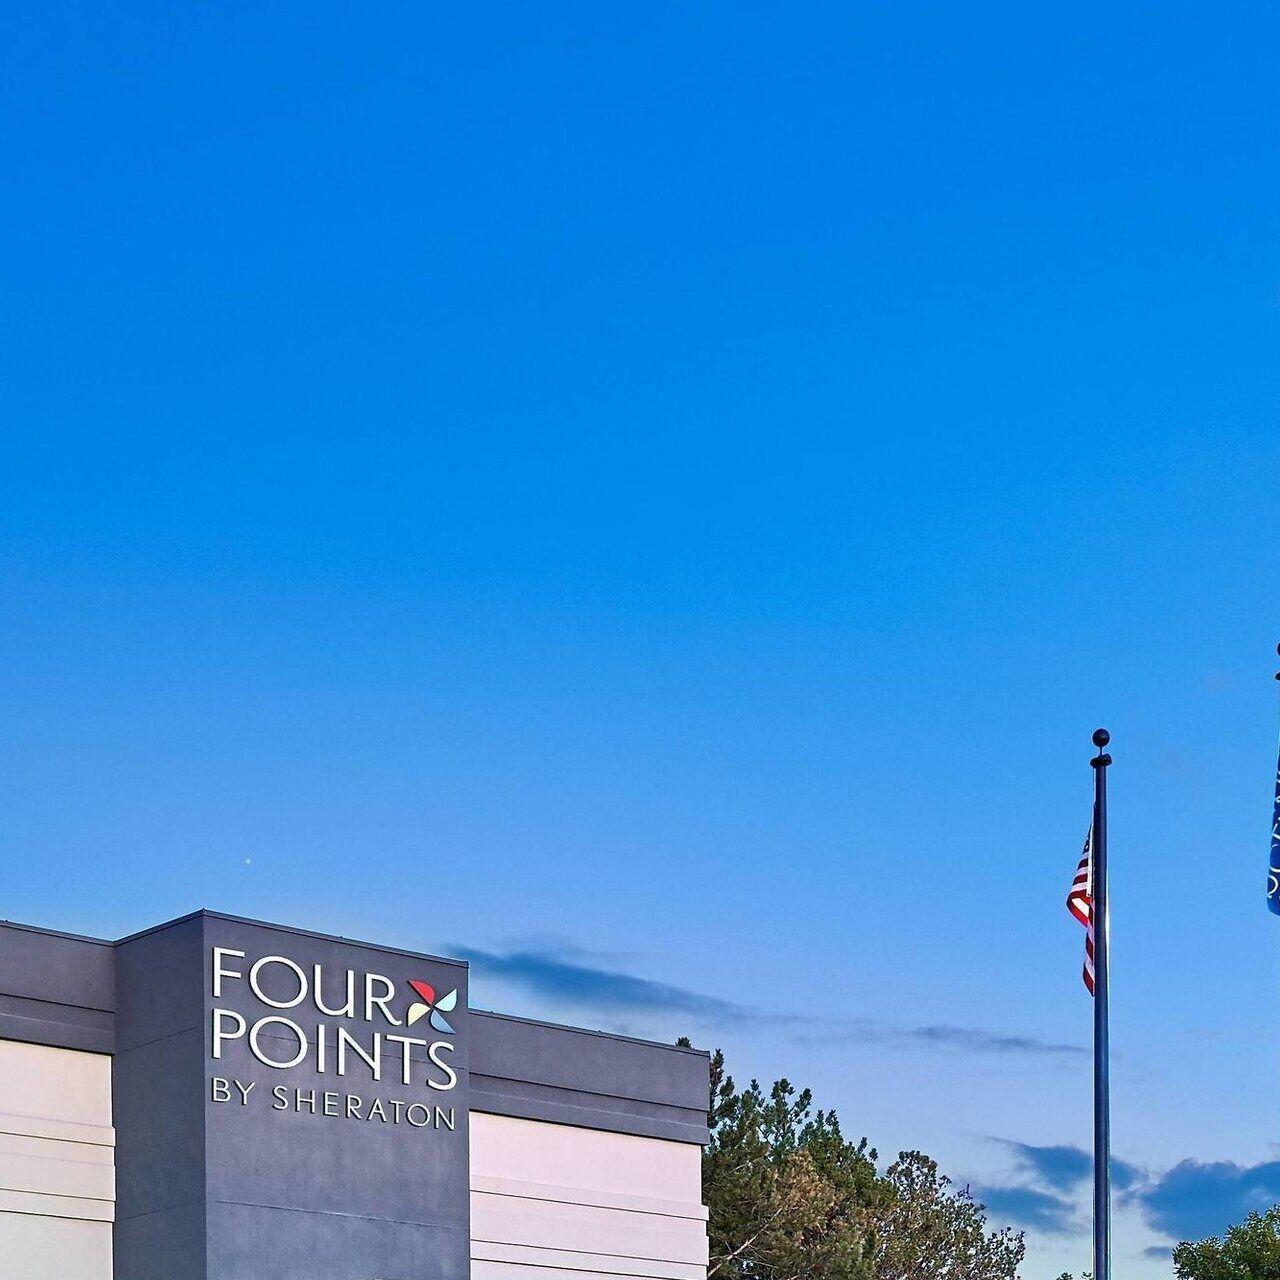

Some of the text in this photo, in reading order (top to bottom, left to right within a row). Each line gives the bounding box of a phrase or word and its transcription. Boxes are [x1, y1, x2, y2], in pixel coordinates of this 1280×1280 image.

[213, 946, 402, 1026] FOUR
[212, 1007, 458, 1091] POINTS
[211, 1076, 455, 1131] BY SHERATON
